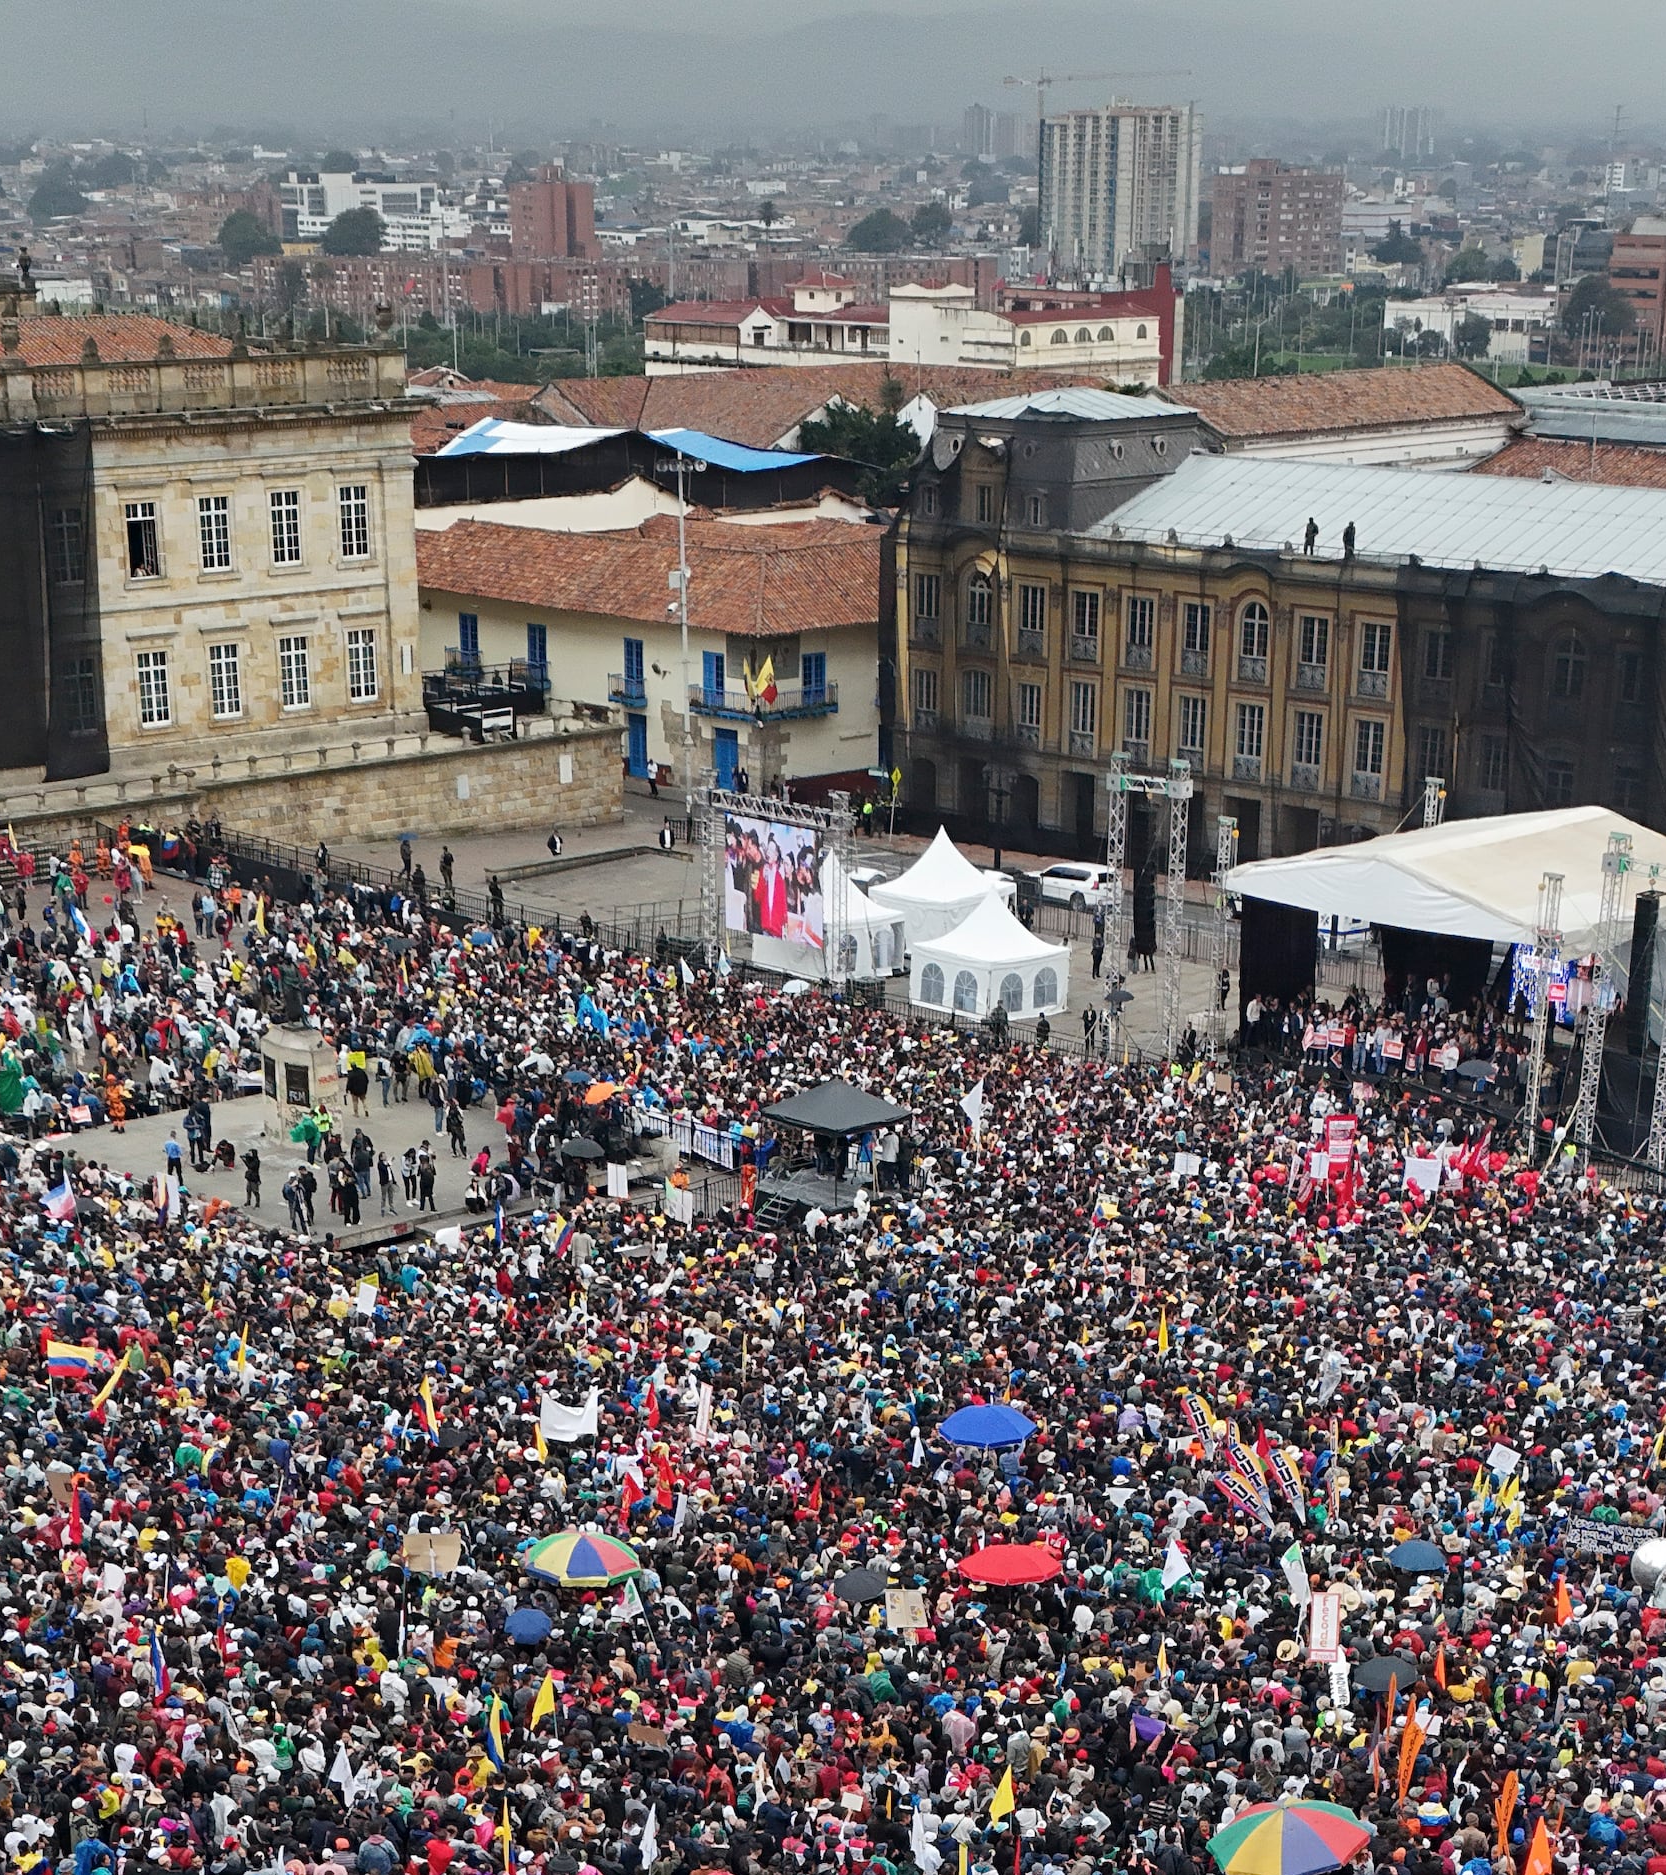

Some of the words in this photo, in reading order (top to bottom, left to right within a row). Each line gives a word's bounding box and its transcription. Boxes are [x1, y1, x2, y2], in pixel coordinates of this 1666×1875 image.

[1188, 1399, 1210, 1441] CUT
[1232, 1448, 1262, 1488] CUT
[1270, 1453, 1299, 1498] CUT
[1221, 1475, 1260, 1511] CUT
